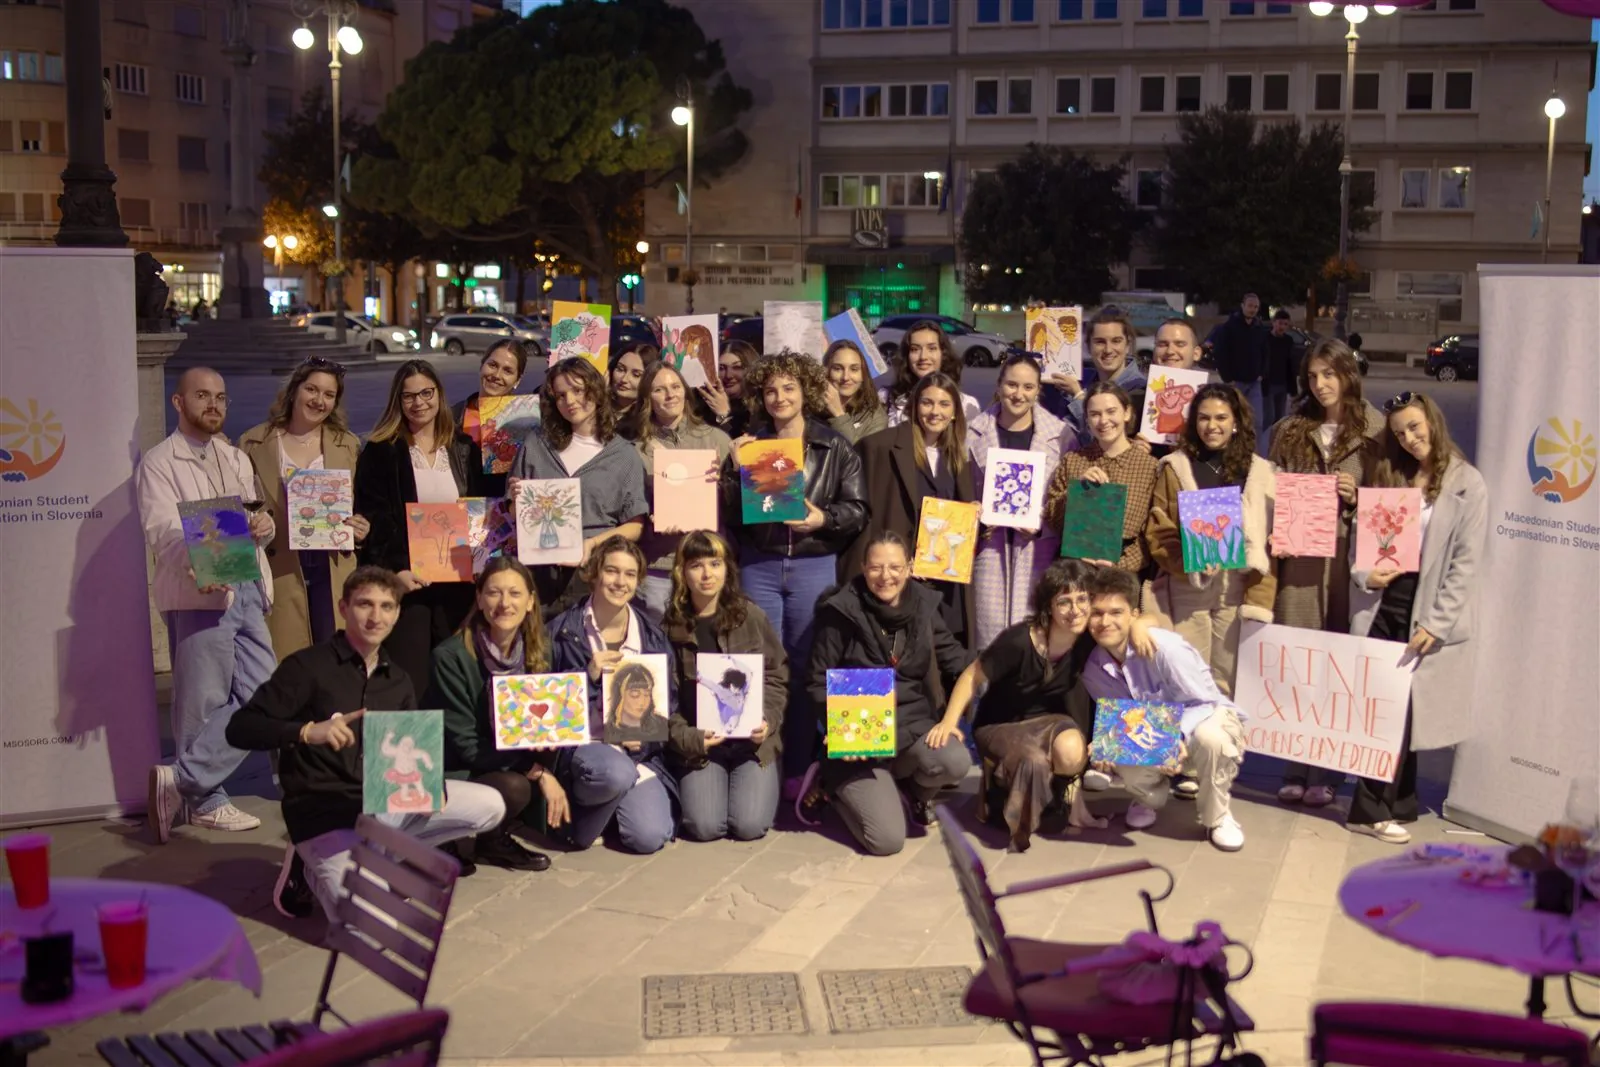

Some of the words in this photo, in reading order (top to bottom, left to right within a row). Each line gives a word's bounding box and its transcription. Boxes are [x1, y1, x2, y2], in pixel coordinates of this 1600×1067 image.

[37, 494, 89, 507] Student
[0, 511, 28, 523] tion
[31, 511, 43, 521] in
[47, 508, 103, 521] Slovenia
[1504, 511, 1564, 530] Macedonian
[1496, 524, 1558, 544] Organisation
[1560, 534, 1570, 546] in
[1259, 640, 1383, 698] PAINT
[1257, 678, 1286, 721] &
[1292, 686, 1396, 743] WINE
[3, 735, 73, 748] MSOSORG.COM
[1308, 737, 1338, 762] DAY
[1338, 741, 1397, 777] EDITION
